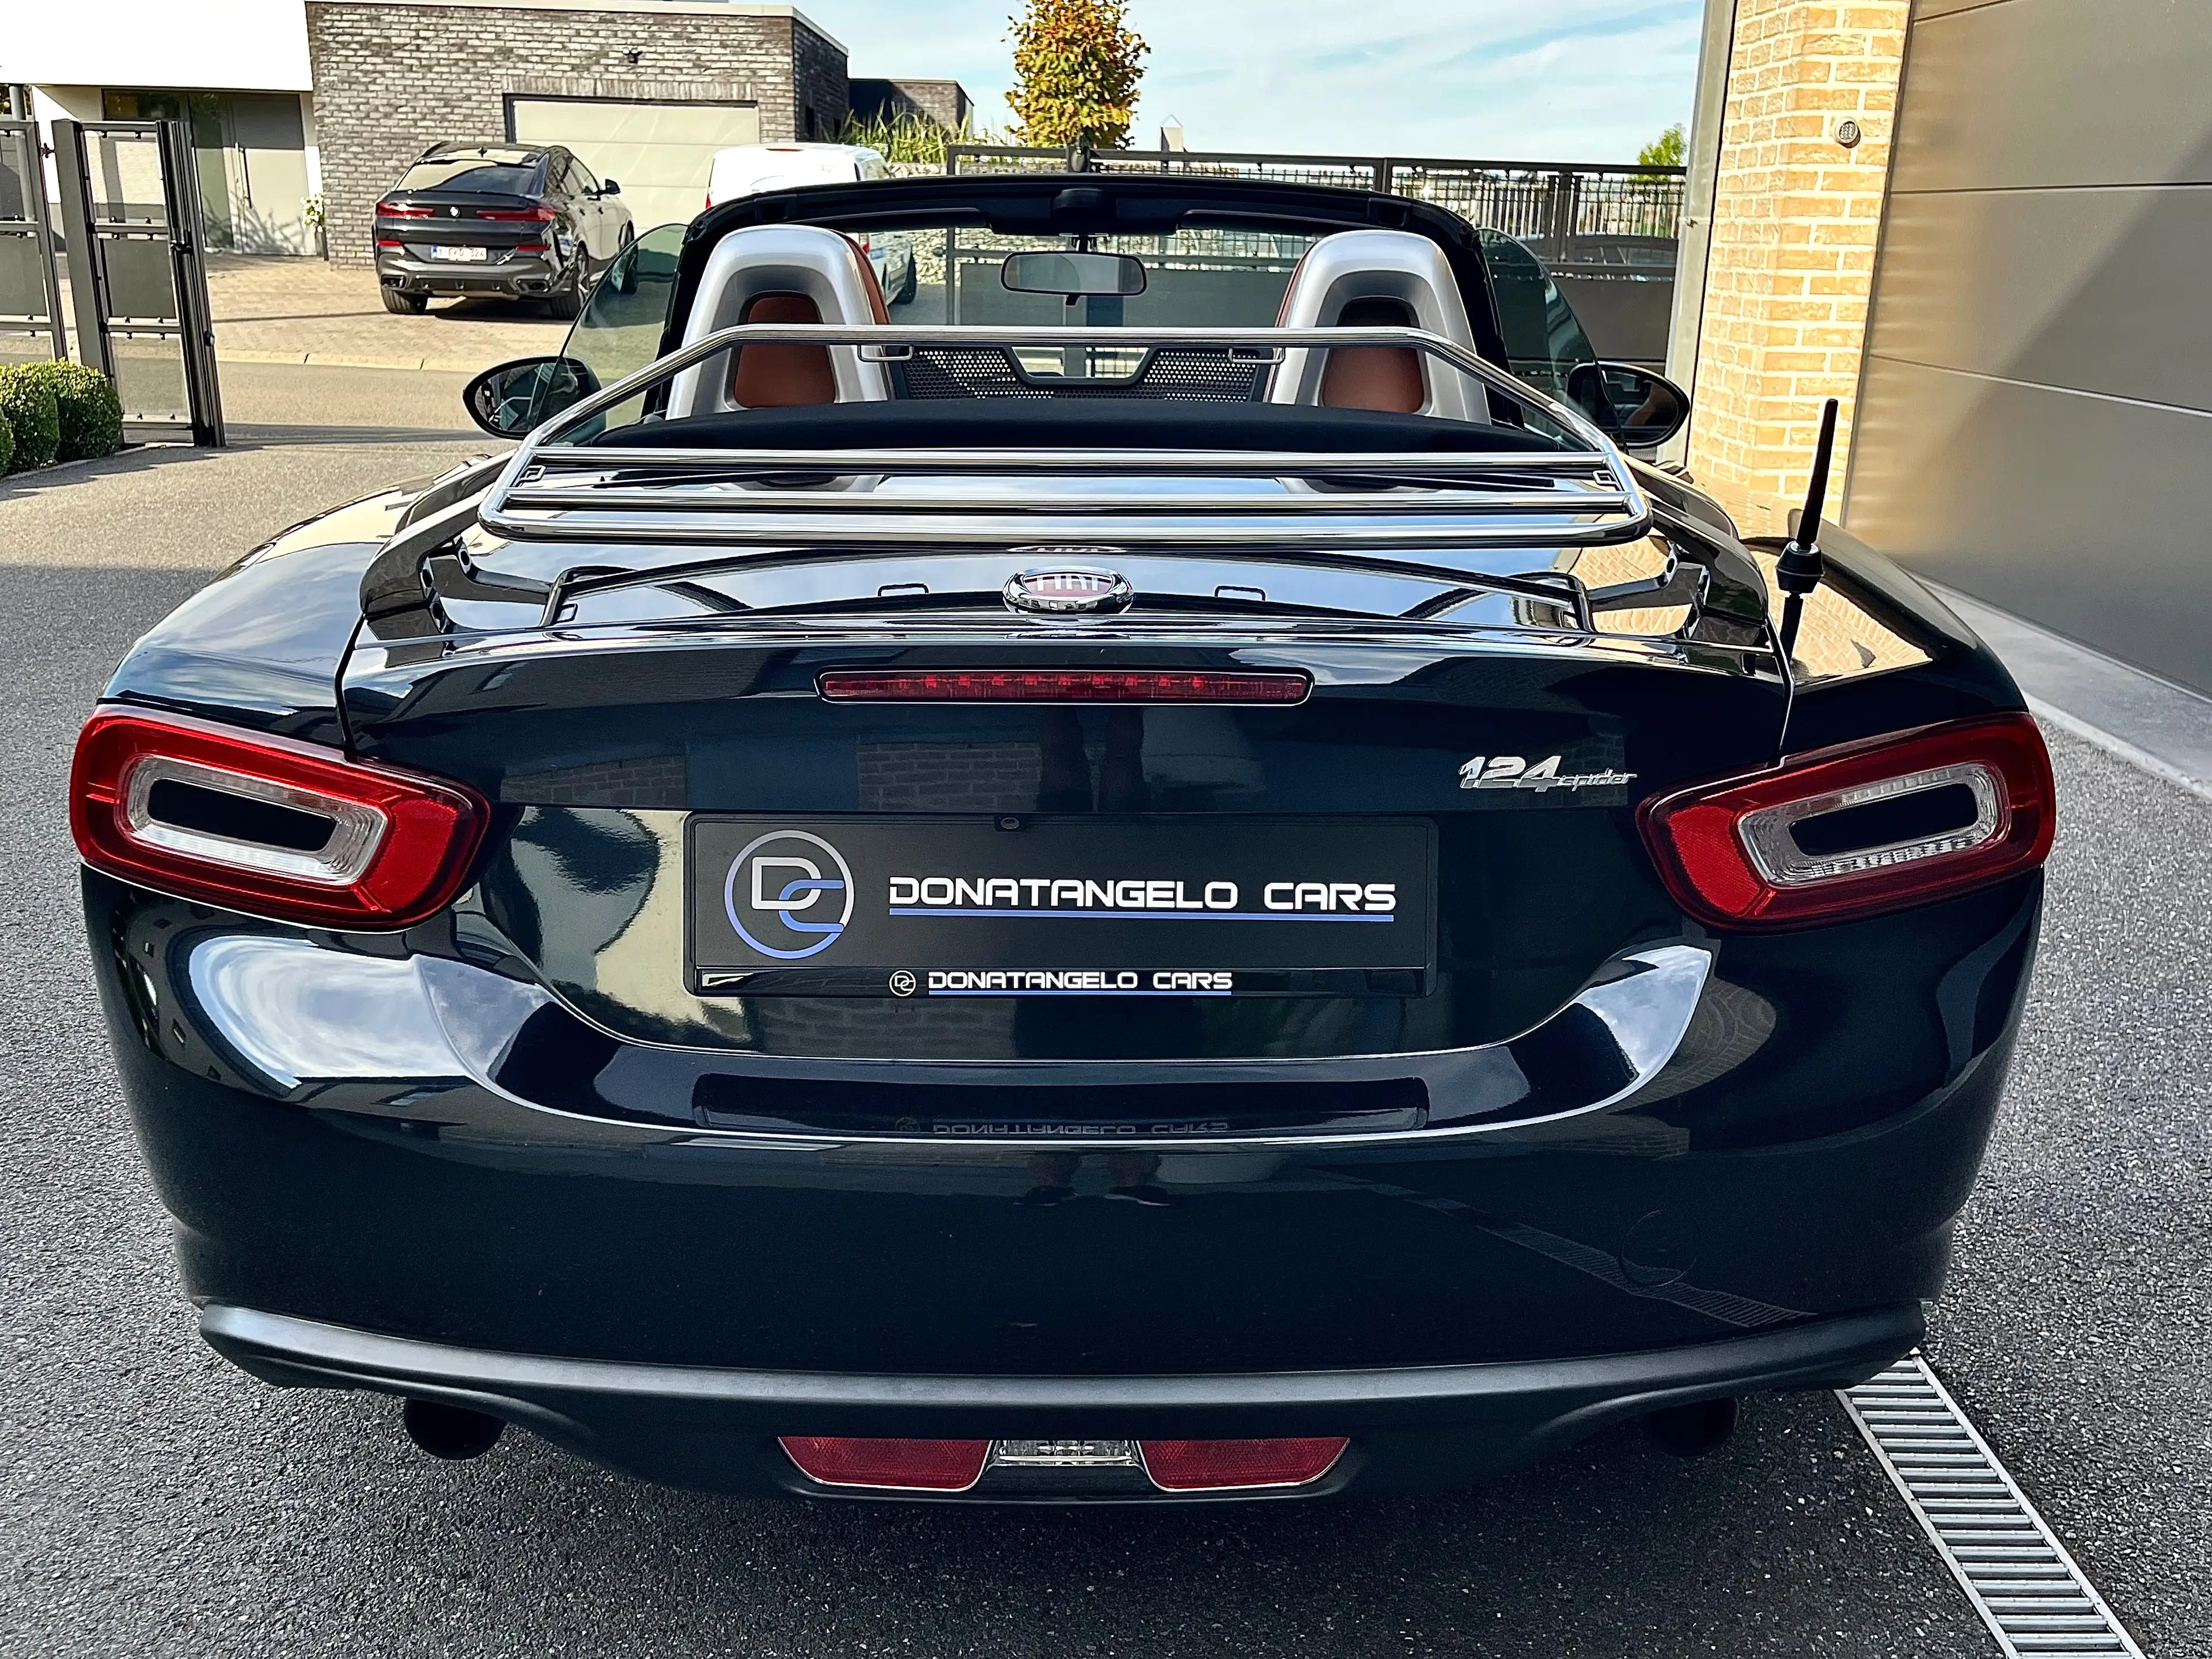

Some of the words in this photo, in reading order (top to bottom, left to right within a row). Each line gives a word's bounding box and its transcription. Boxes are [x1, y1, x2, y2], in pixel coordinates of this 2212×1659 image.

[1036, 575, 1099, 592] FIAT
[1459, 755, 1562, 793] 124
[1556, 768, 1638, 791] spider
[889, 877, 1238, 909] DONATANGELO
[1264, 882, 1396, 911] CARS
[928, 971, 1138, 989] DONATANGELO
[1153, 972, 1233, 989] CARS
